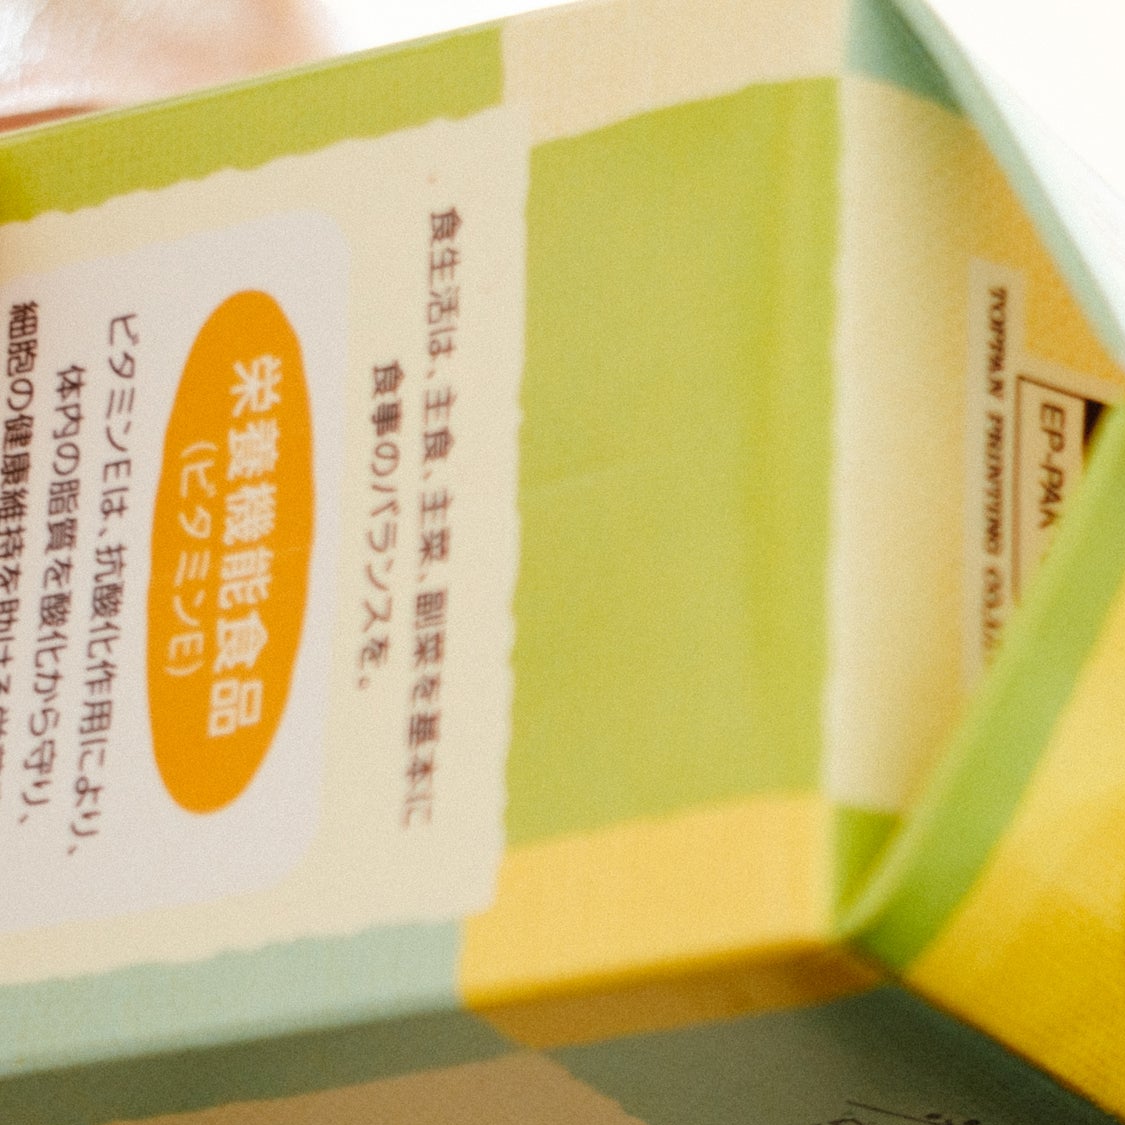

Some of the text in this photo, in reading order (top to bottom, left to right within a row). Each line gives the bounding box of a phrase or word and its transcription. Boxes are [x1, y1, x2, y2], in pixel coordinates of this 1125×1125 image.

[986, 286, 1007, 398] TOPPAN
[207, 354, 282, 738] 栄養機能食品
[357, 360, 405, 691] 食事のバランスを。
[984, 411, 1004, 556] PRINTING
